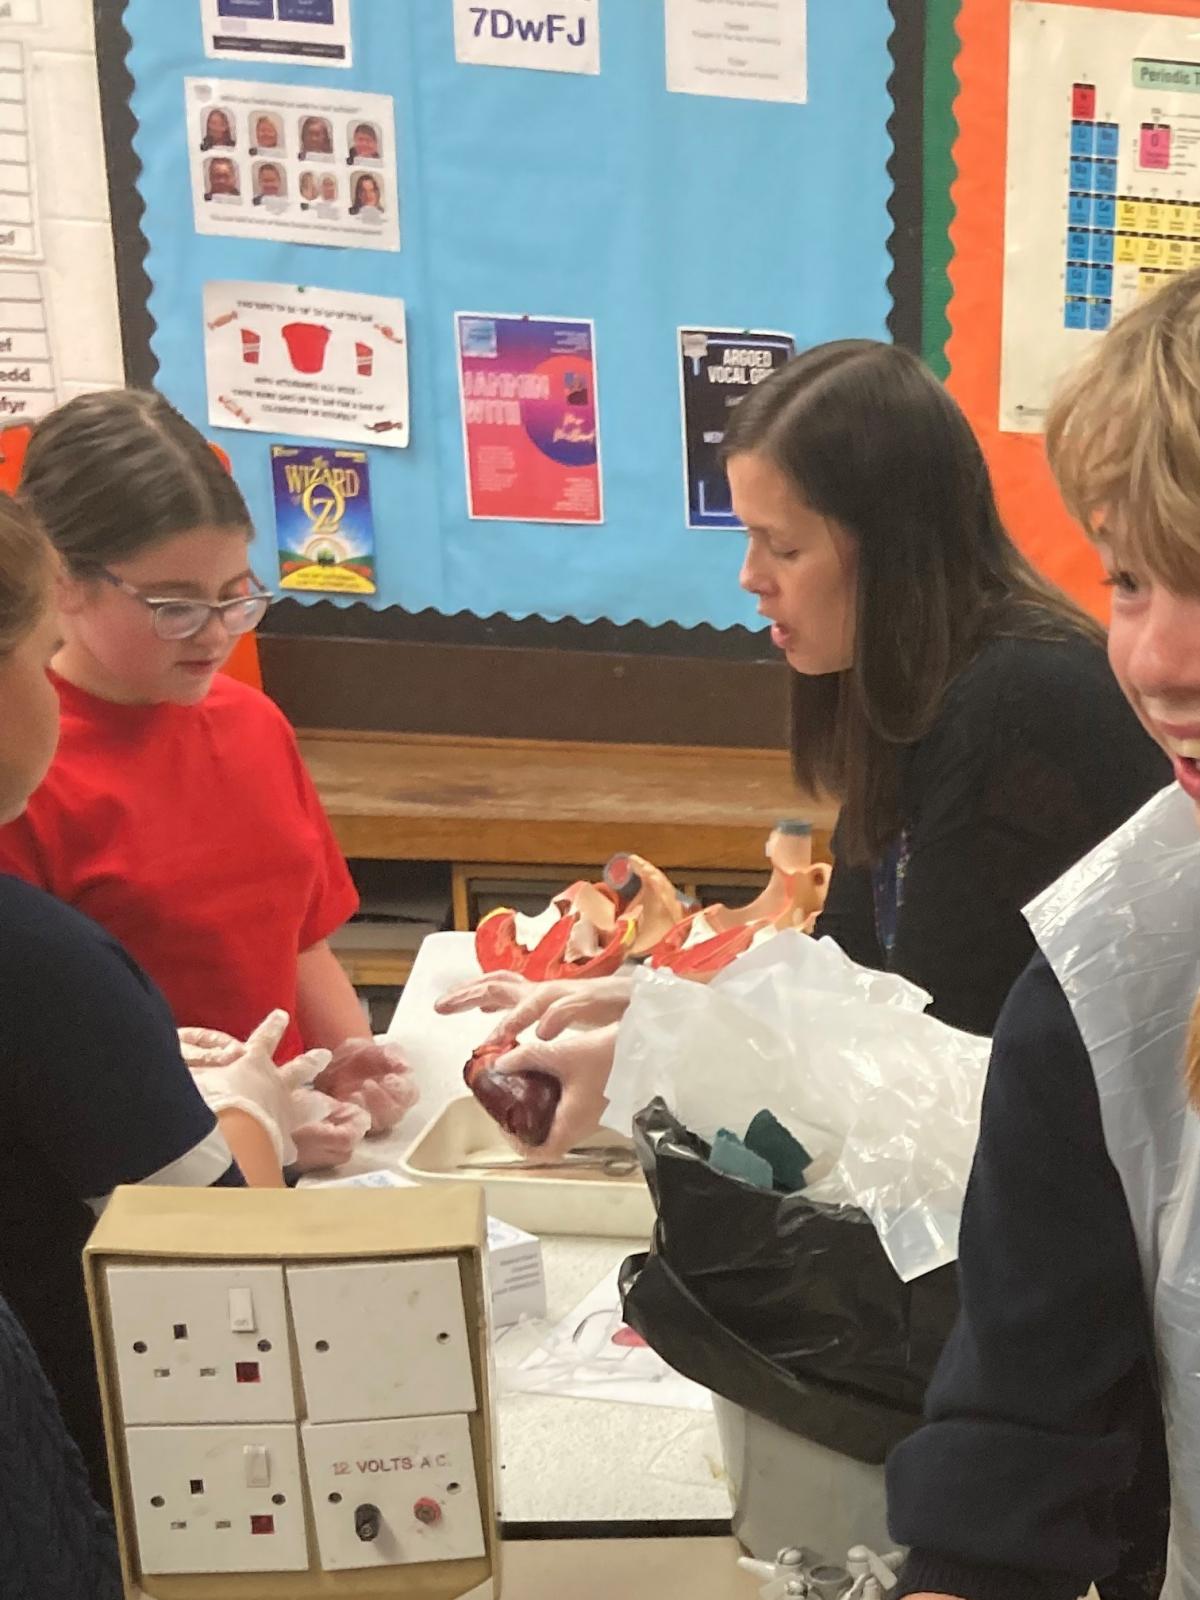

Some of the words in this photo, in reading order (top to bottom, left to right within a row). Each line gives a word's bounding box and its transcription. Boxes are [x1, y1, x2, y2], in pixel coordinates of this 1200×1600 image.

[469, 7, 586, 47] 7DwFJ
[1140, 66, 1190, 85] Periodic
[723, 348, 772, 368] ARGOED
[707, 365, 748, 385] VOCAL
[284, 464, 361, 498] WIZARD
[332, 1462, 351, 1476] 12
[356, 1456, 413, 1474] VOLTS
